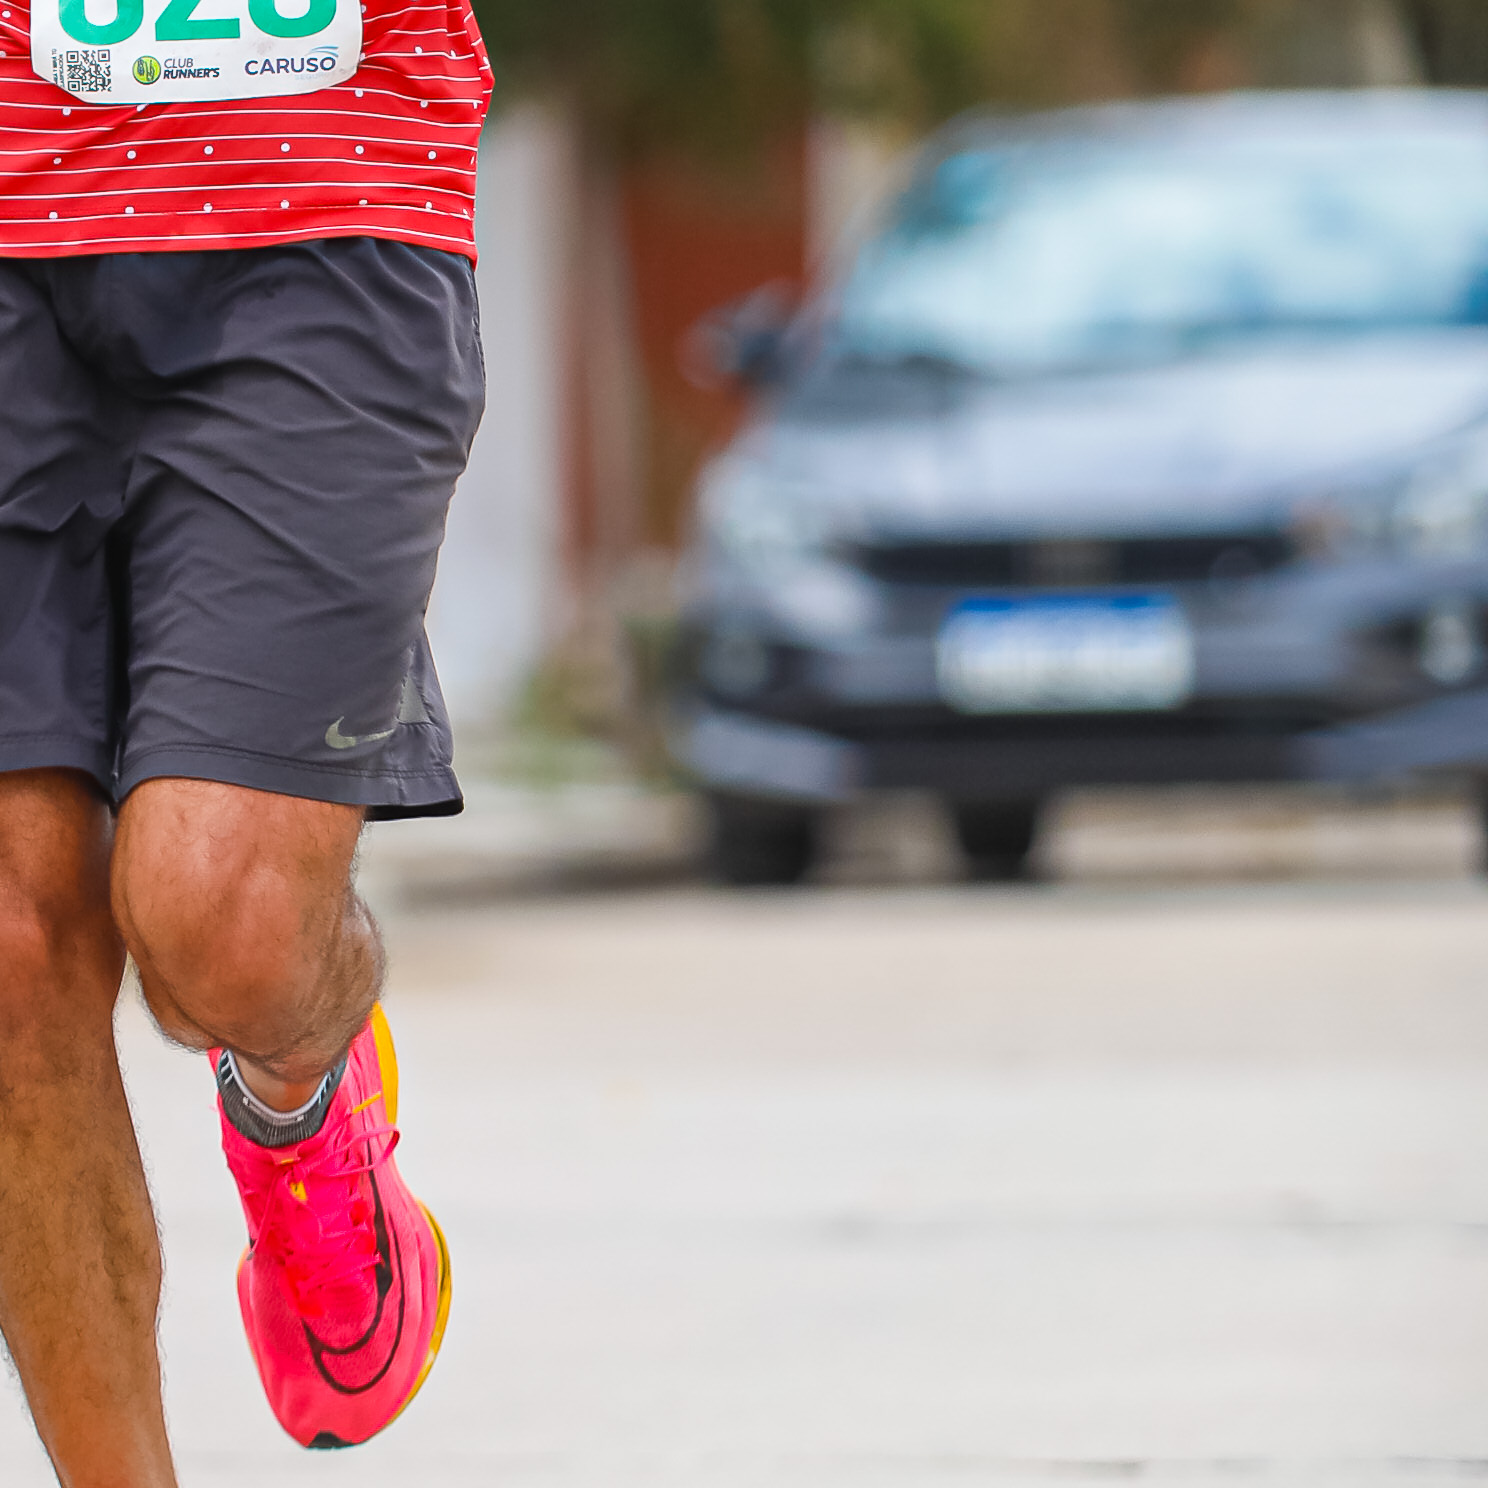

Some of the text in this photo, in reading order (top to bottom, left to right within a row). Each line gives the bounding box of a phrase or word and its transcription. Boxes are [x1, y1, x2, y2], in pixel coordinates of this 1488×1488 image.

[164, 58, 194, 69] CLUB
[245, 57, 337, 76] CARUSO
[163, 68, 220, 80] RUNNER'S
